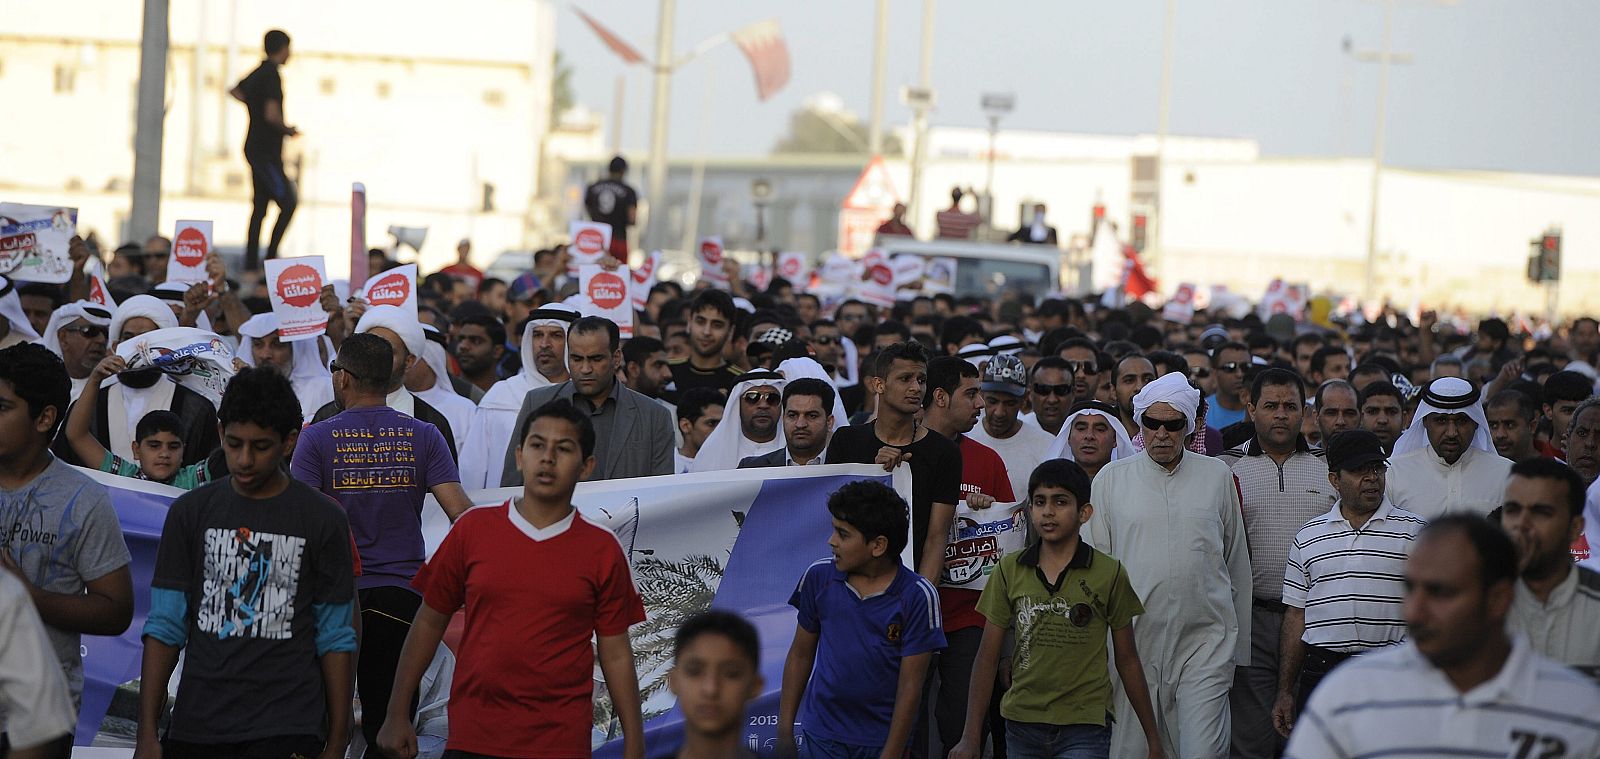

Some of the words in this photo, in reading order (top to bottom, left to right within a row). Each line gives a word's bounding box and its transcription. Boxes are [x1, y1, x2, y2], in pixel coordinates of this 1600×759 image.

[379, 427, 414, 437] CREW
[336, 442, 369, 453] LUXURY
[343, 452, 408, 463] COMPETITION
[961, 539, 996, 556] إضراب
[953, 568, 968, 579] 14
[749, 715, 778, 726] 2013
